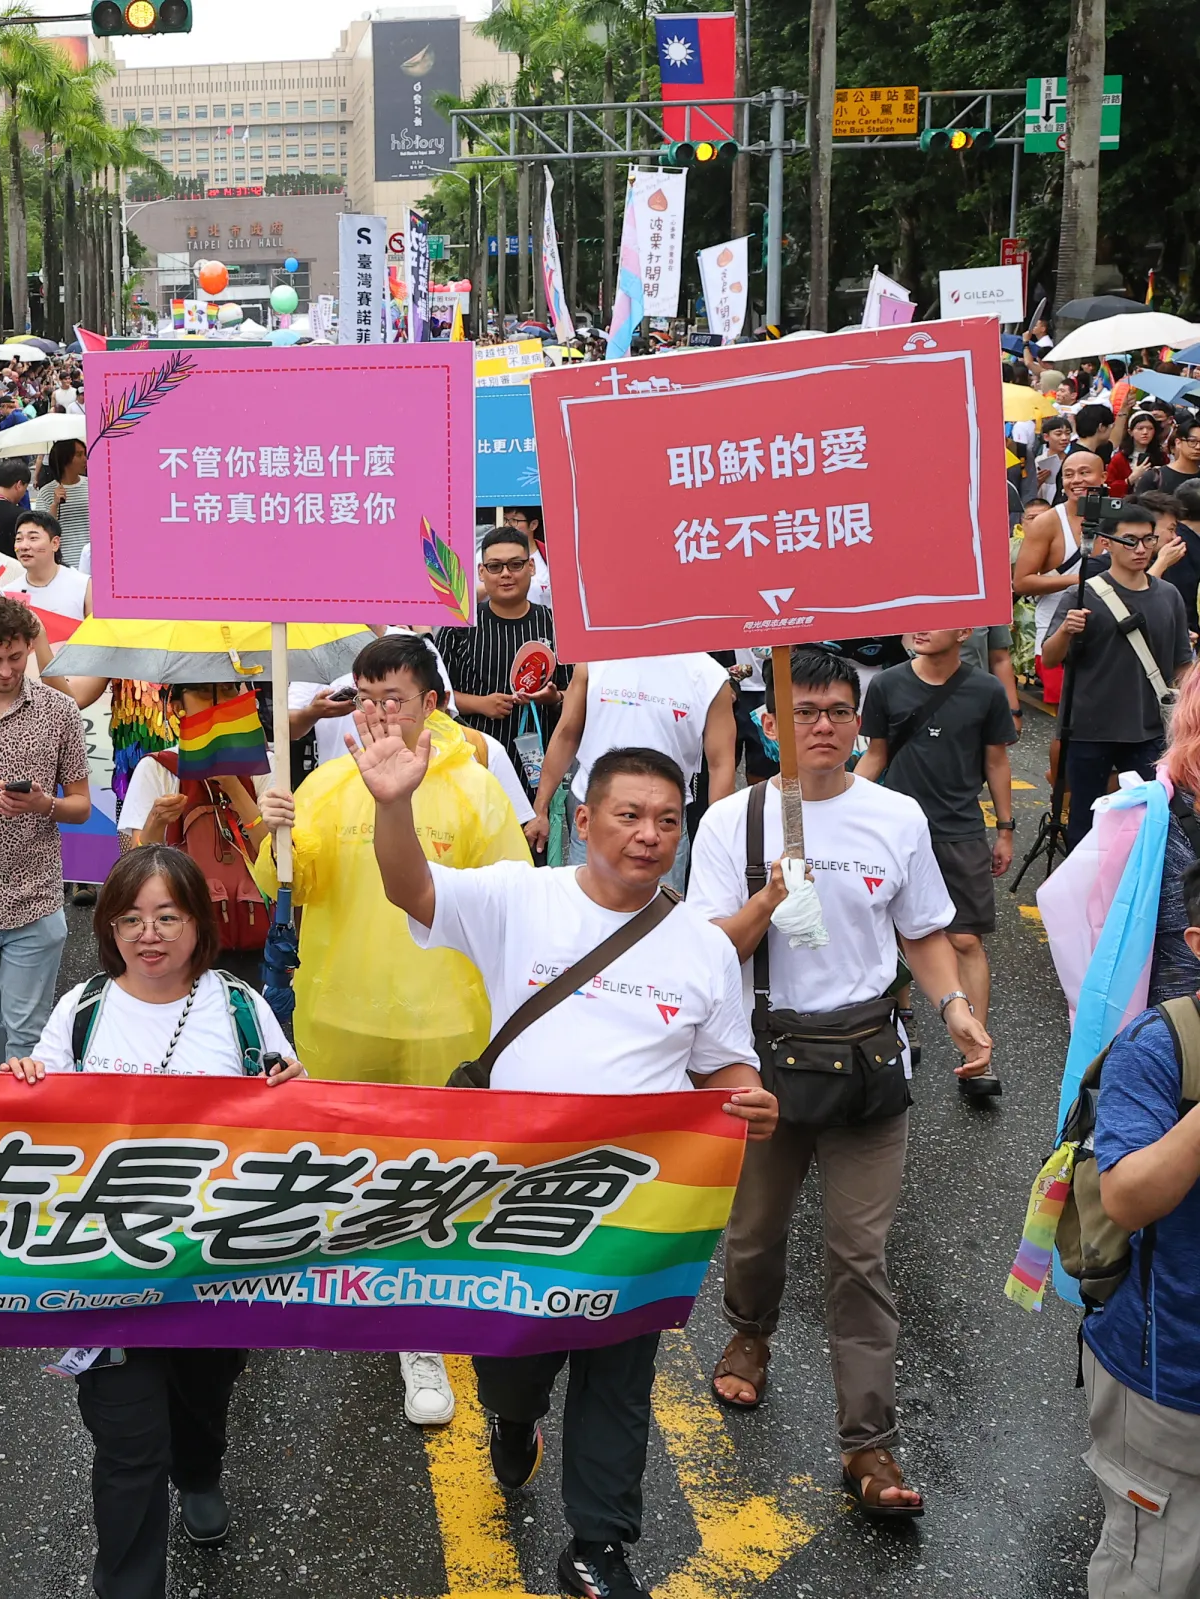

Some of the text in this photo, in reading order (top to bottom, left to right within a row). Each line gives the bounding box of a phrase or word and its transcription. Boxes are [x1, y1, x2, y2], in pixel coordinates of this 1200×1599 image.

[836, 103, 915, 117] 小心駕駛
[187, 221, 284, 239] 臺北市政府
[187, 237, 283, 250] TAIPEI CITY HALL
[356, 253, 373, 344] 臺灣賽諾菲
[963, 289, 1004, 300] GILEAD
[508, 353, 541, 367] 不是病
[158, 444, 396, 478] 不管你聽過什麼
[666, 425, 869, 490] 耶穌的愛
[160, 492, 396, 525] 上帝真的很愛你
[673, 502, 874, 564] 從不設限
[426, 826, 455, 842] TRUTH
[806, 858, 886, 875] BELIEVE TRUTH
[532, 961, 559, 977] LOVE
[592, 975, 683, 1004] BELIEVE TRUTH
[114, 1058, 138, 1074] GOD
[39, 1287, 162, 1311] Church
[197, 1267, 616, 1318] www.TKchurch.org
